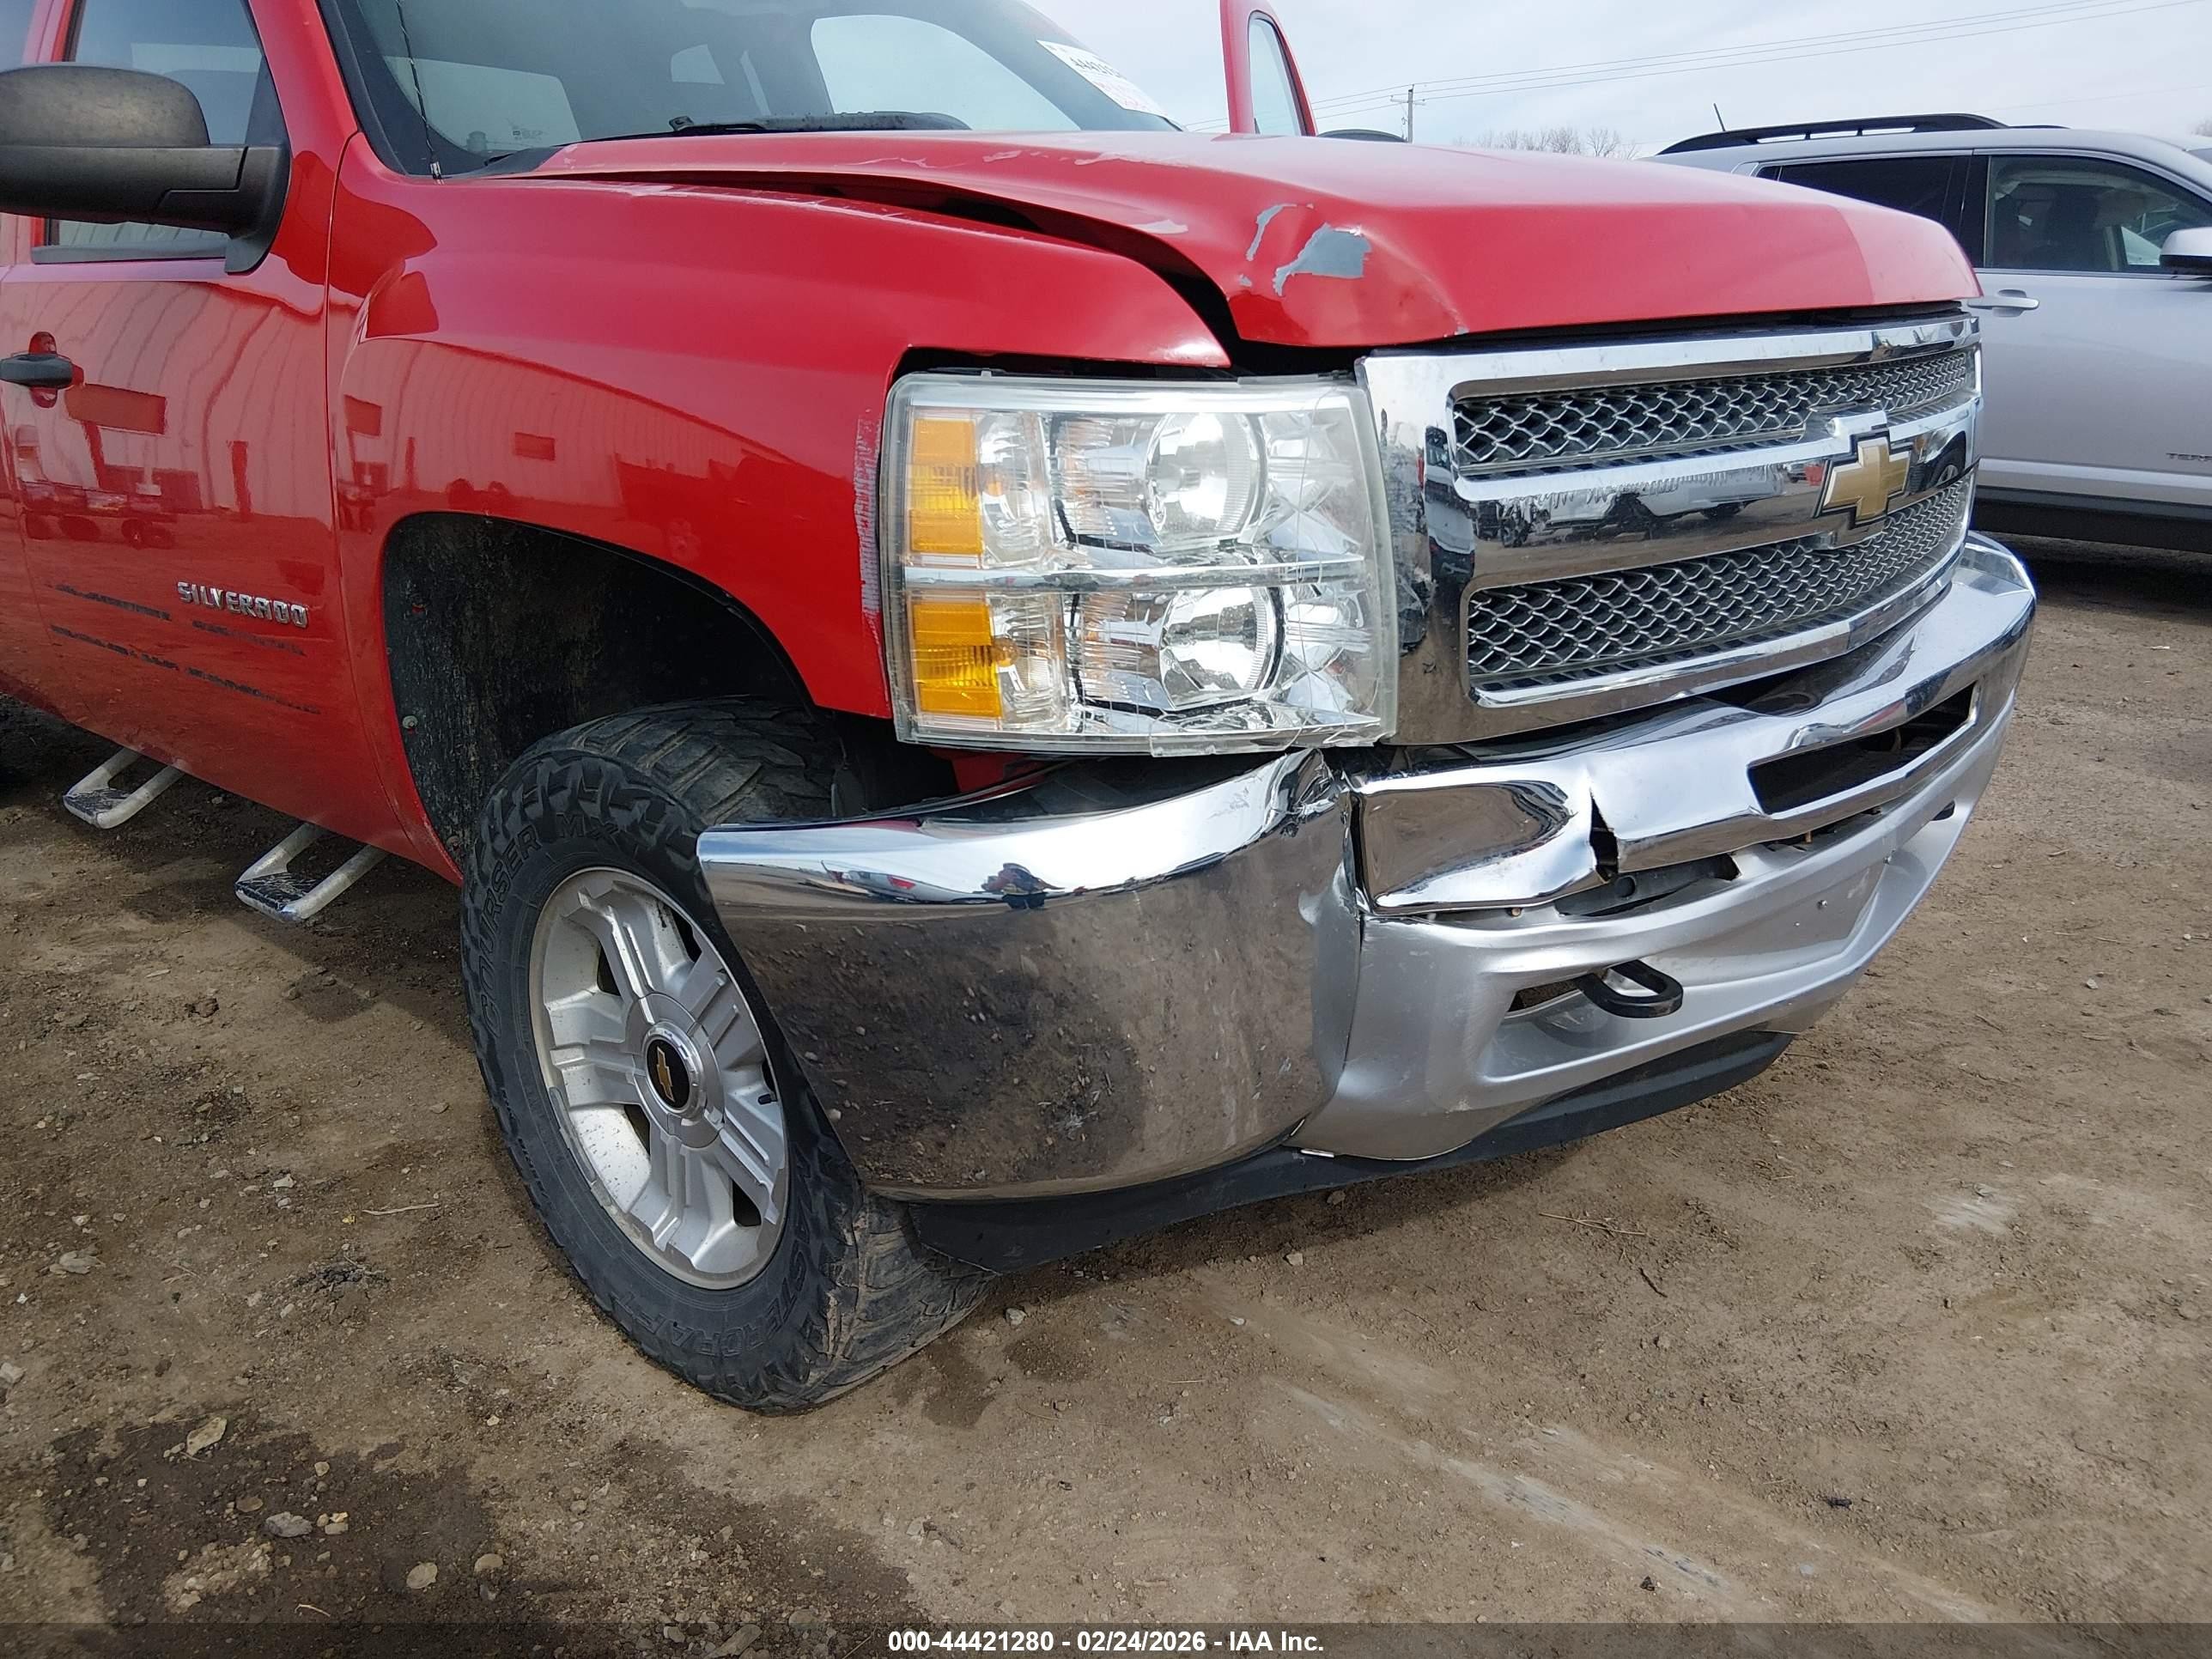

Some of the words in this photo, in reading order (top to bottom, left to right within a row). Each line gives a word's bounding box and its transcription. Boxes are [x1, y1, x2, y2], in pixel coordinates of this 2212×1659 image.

[177, 580, 309, 629] SILVERADO
[477, 824, 543, 1039] COURSER
[556, 811, 619, 842] MX
